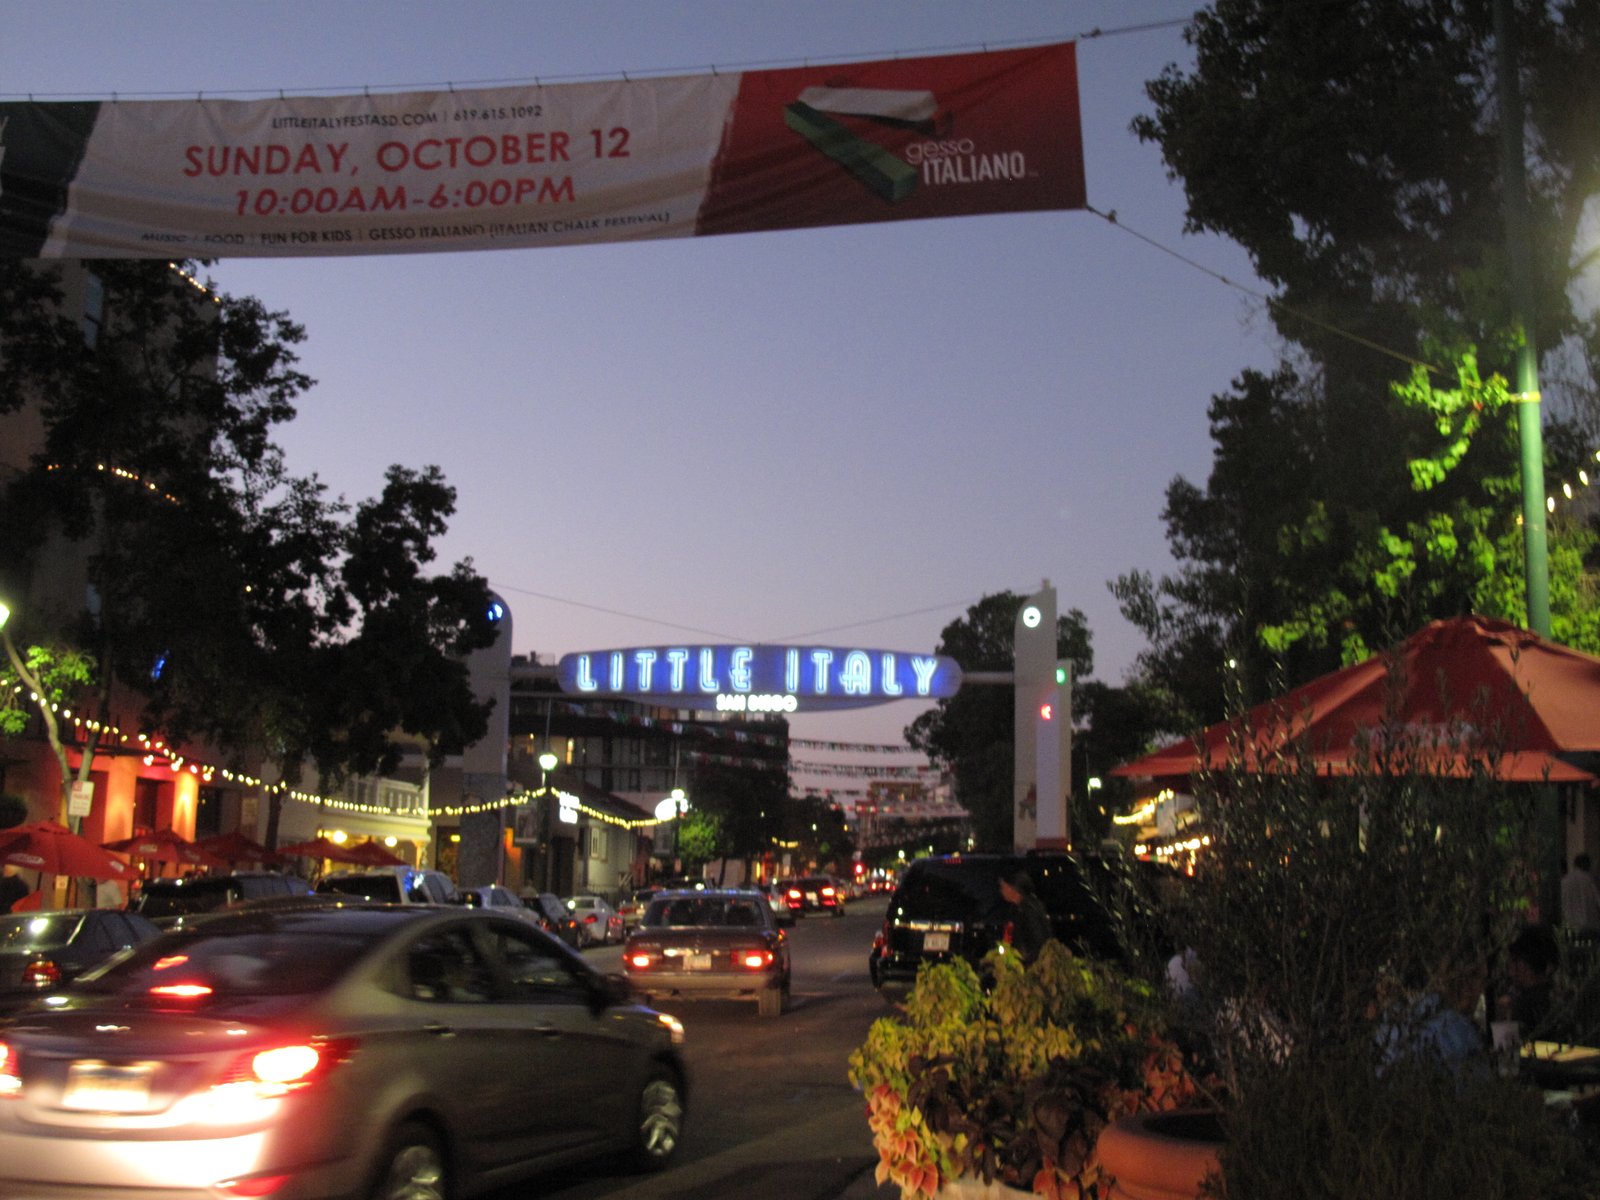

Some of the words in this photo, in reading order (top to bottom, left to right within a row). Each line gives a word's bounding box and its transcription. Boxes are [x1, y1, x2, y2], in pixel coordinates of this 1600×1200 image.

[272, 112, 437, 129] LITTLEITALYFESTASD.COM
[183, 143, 358, 177] SUNDAY,
[376, 131, 571, 172] OCTOBER
[590, 126, 630, 159] 12
[906, 138, 975, 165] gesso
[923, 151, 1025, 185] ITALIANO
[204, 234, 244, 245] FOOD
[261, 232, 287, 245] FUN
[291, 231, 318, 244] FOR
[322, 229, 351, 242] KIDS
[369, 227, 416, 241] GESSO
[419, 224, 485, 239] ITALIANO
[553, 216, 599, 233] CHALK
[577, 648, 752, 692] LITTLE
[786, 649, 938, 695] ITALY
[716, 694, 746, 711] SAN
[747, 694, 797, 712] DIEGO
